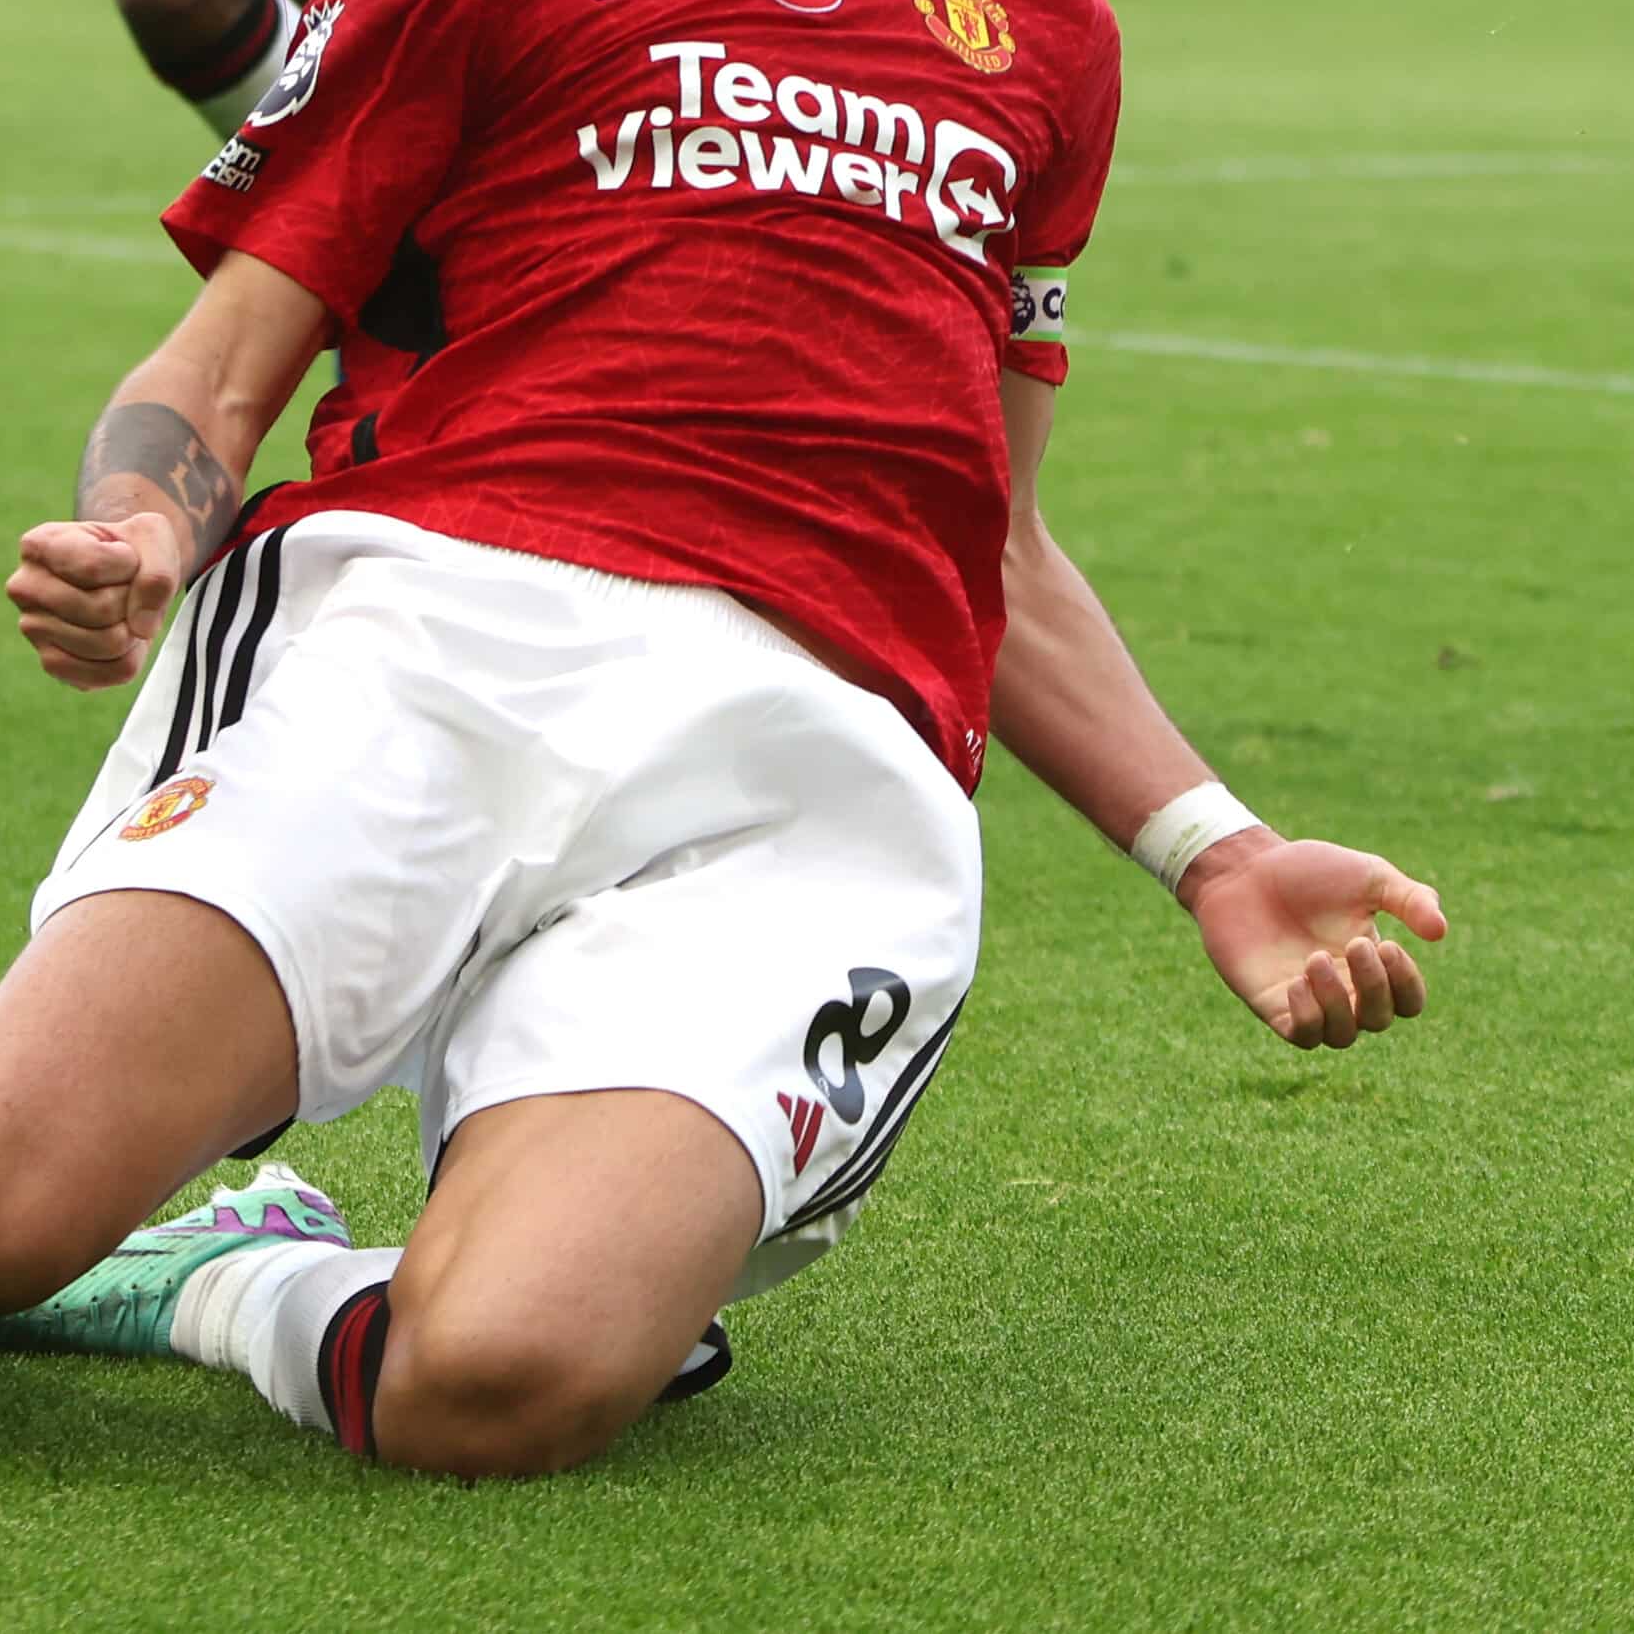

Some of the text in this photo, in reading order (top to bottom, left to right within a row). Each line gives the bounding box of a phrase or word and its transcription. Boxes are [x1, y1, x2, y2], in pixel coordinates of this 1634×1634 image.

[576, 106, 920, 222] Viewer
[648, 40, 926, 166] Team
[803, 967, 911, 1125] 8
